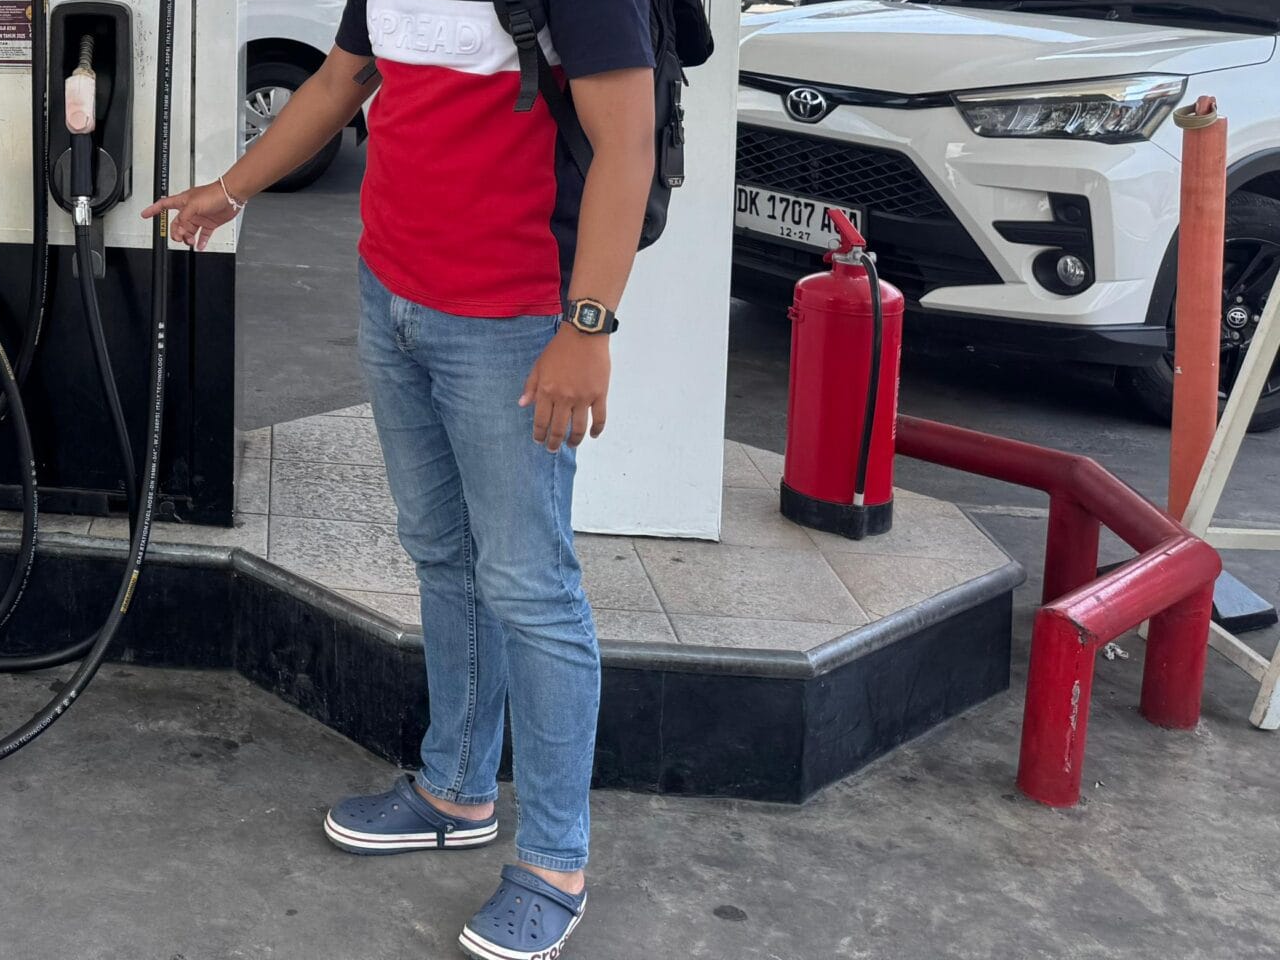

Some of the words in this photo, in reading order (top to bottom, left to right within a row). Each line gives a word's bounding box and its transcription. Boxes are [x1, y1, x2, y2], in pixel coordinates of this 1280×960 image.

[737, 187, 760, 216] DK
[766, 194, 815, 228] 1707
[820, 206, 859, 234] AA
